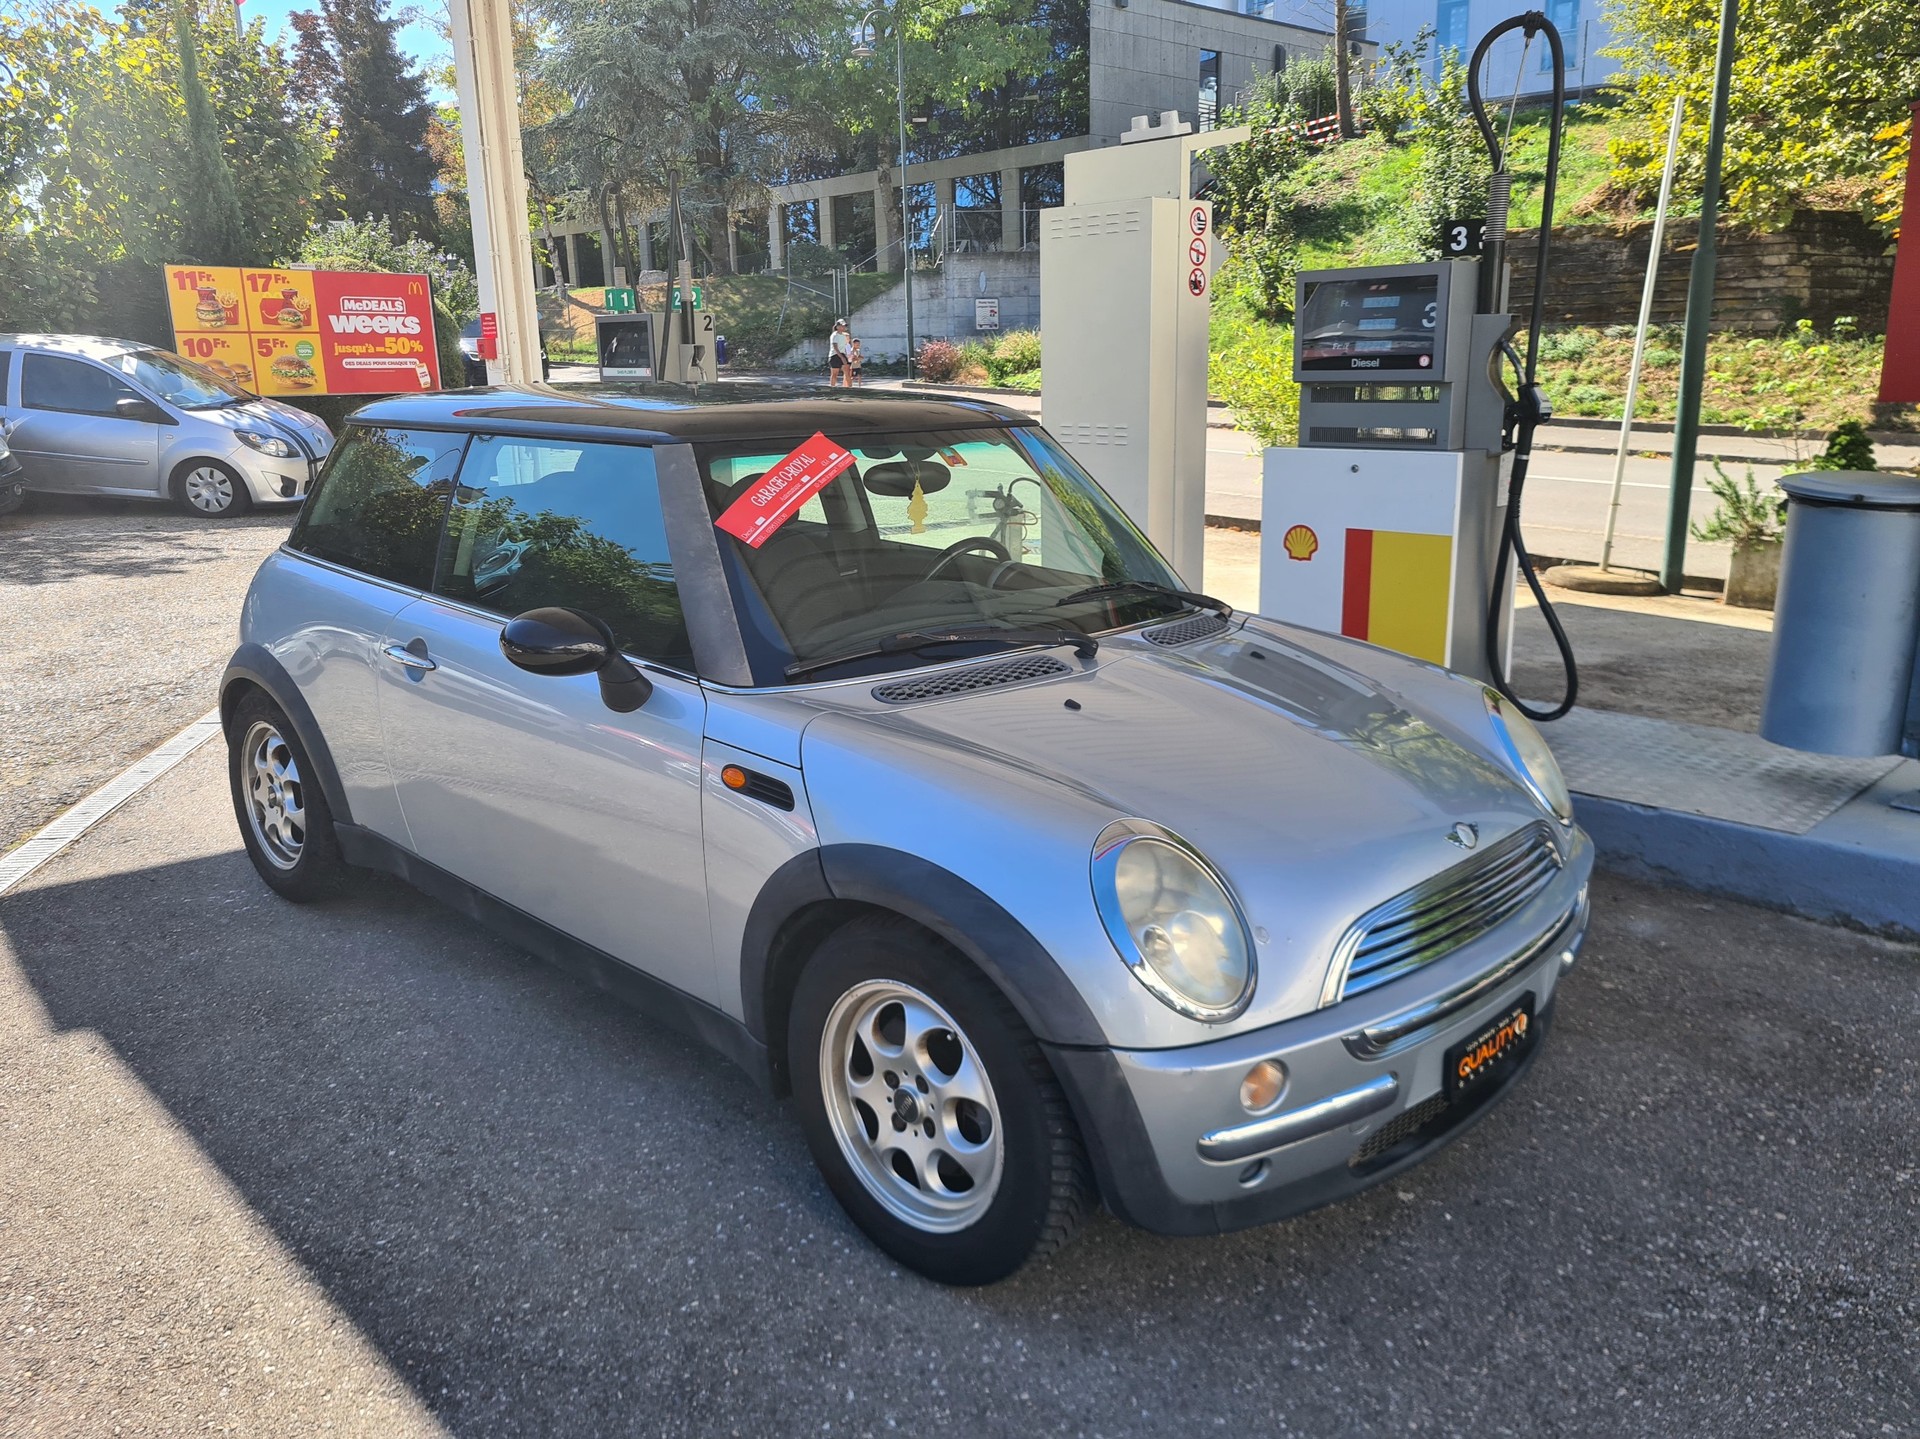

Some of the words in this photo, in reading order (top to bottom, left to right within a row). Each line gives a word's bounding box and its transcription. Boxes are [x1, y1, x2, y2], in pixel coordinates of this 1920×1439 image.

[1450, 226, 1468, 251] 3
[173, 271, 198, 290] 11
[198, 271, 215, 282] Fr.
[246, 273, 273, 292] 17
[274, 274, 290, 284] Fr.
[343, 299, 404, 312] McDEALS
[620, 292, 629, 307] 1
[703, 315, 713, 331] 2
[183, 338, 214, 358] 10
[213, 338, 230, 348] Fr.
[257, 338, 273, 357] 5
[273, 338, 288, 348] Fr.
[1351, 357, 1380, 369] Diesel
[751, 475, 788, 507] GARAGE
[778, 453, 816, 482] O-ROYAL
